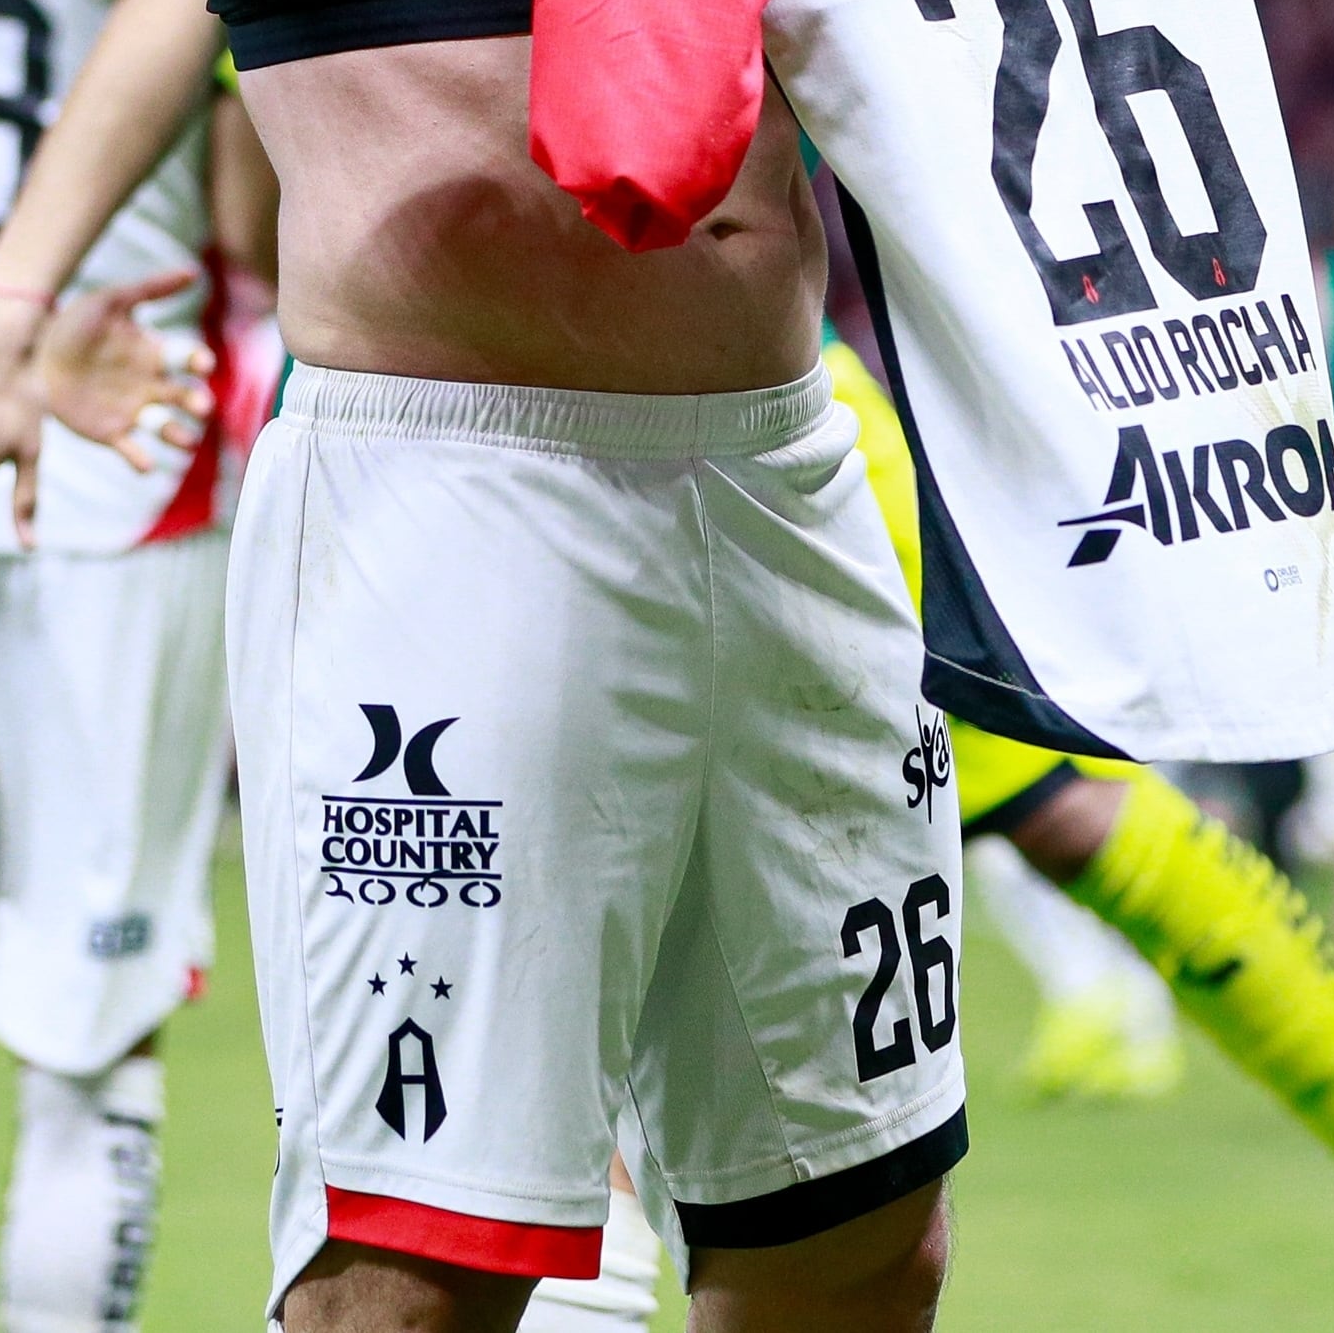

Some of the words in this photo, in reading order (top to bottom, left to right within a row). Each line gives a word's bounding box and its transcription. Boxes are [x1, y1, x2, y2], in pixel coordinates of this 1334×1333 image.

[1060, 325, 1180, 411] ALDO
[1163, 293, 1317, 396] ROCHA
[322, 804, 500, 839] HOSPITAL
[321, 836, 500, 870] COUNTRY
[324, 873, 502, 908] 2000
[840, 873, 956, 1083] 26
